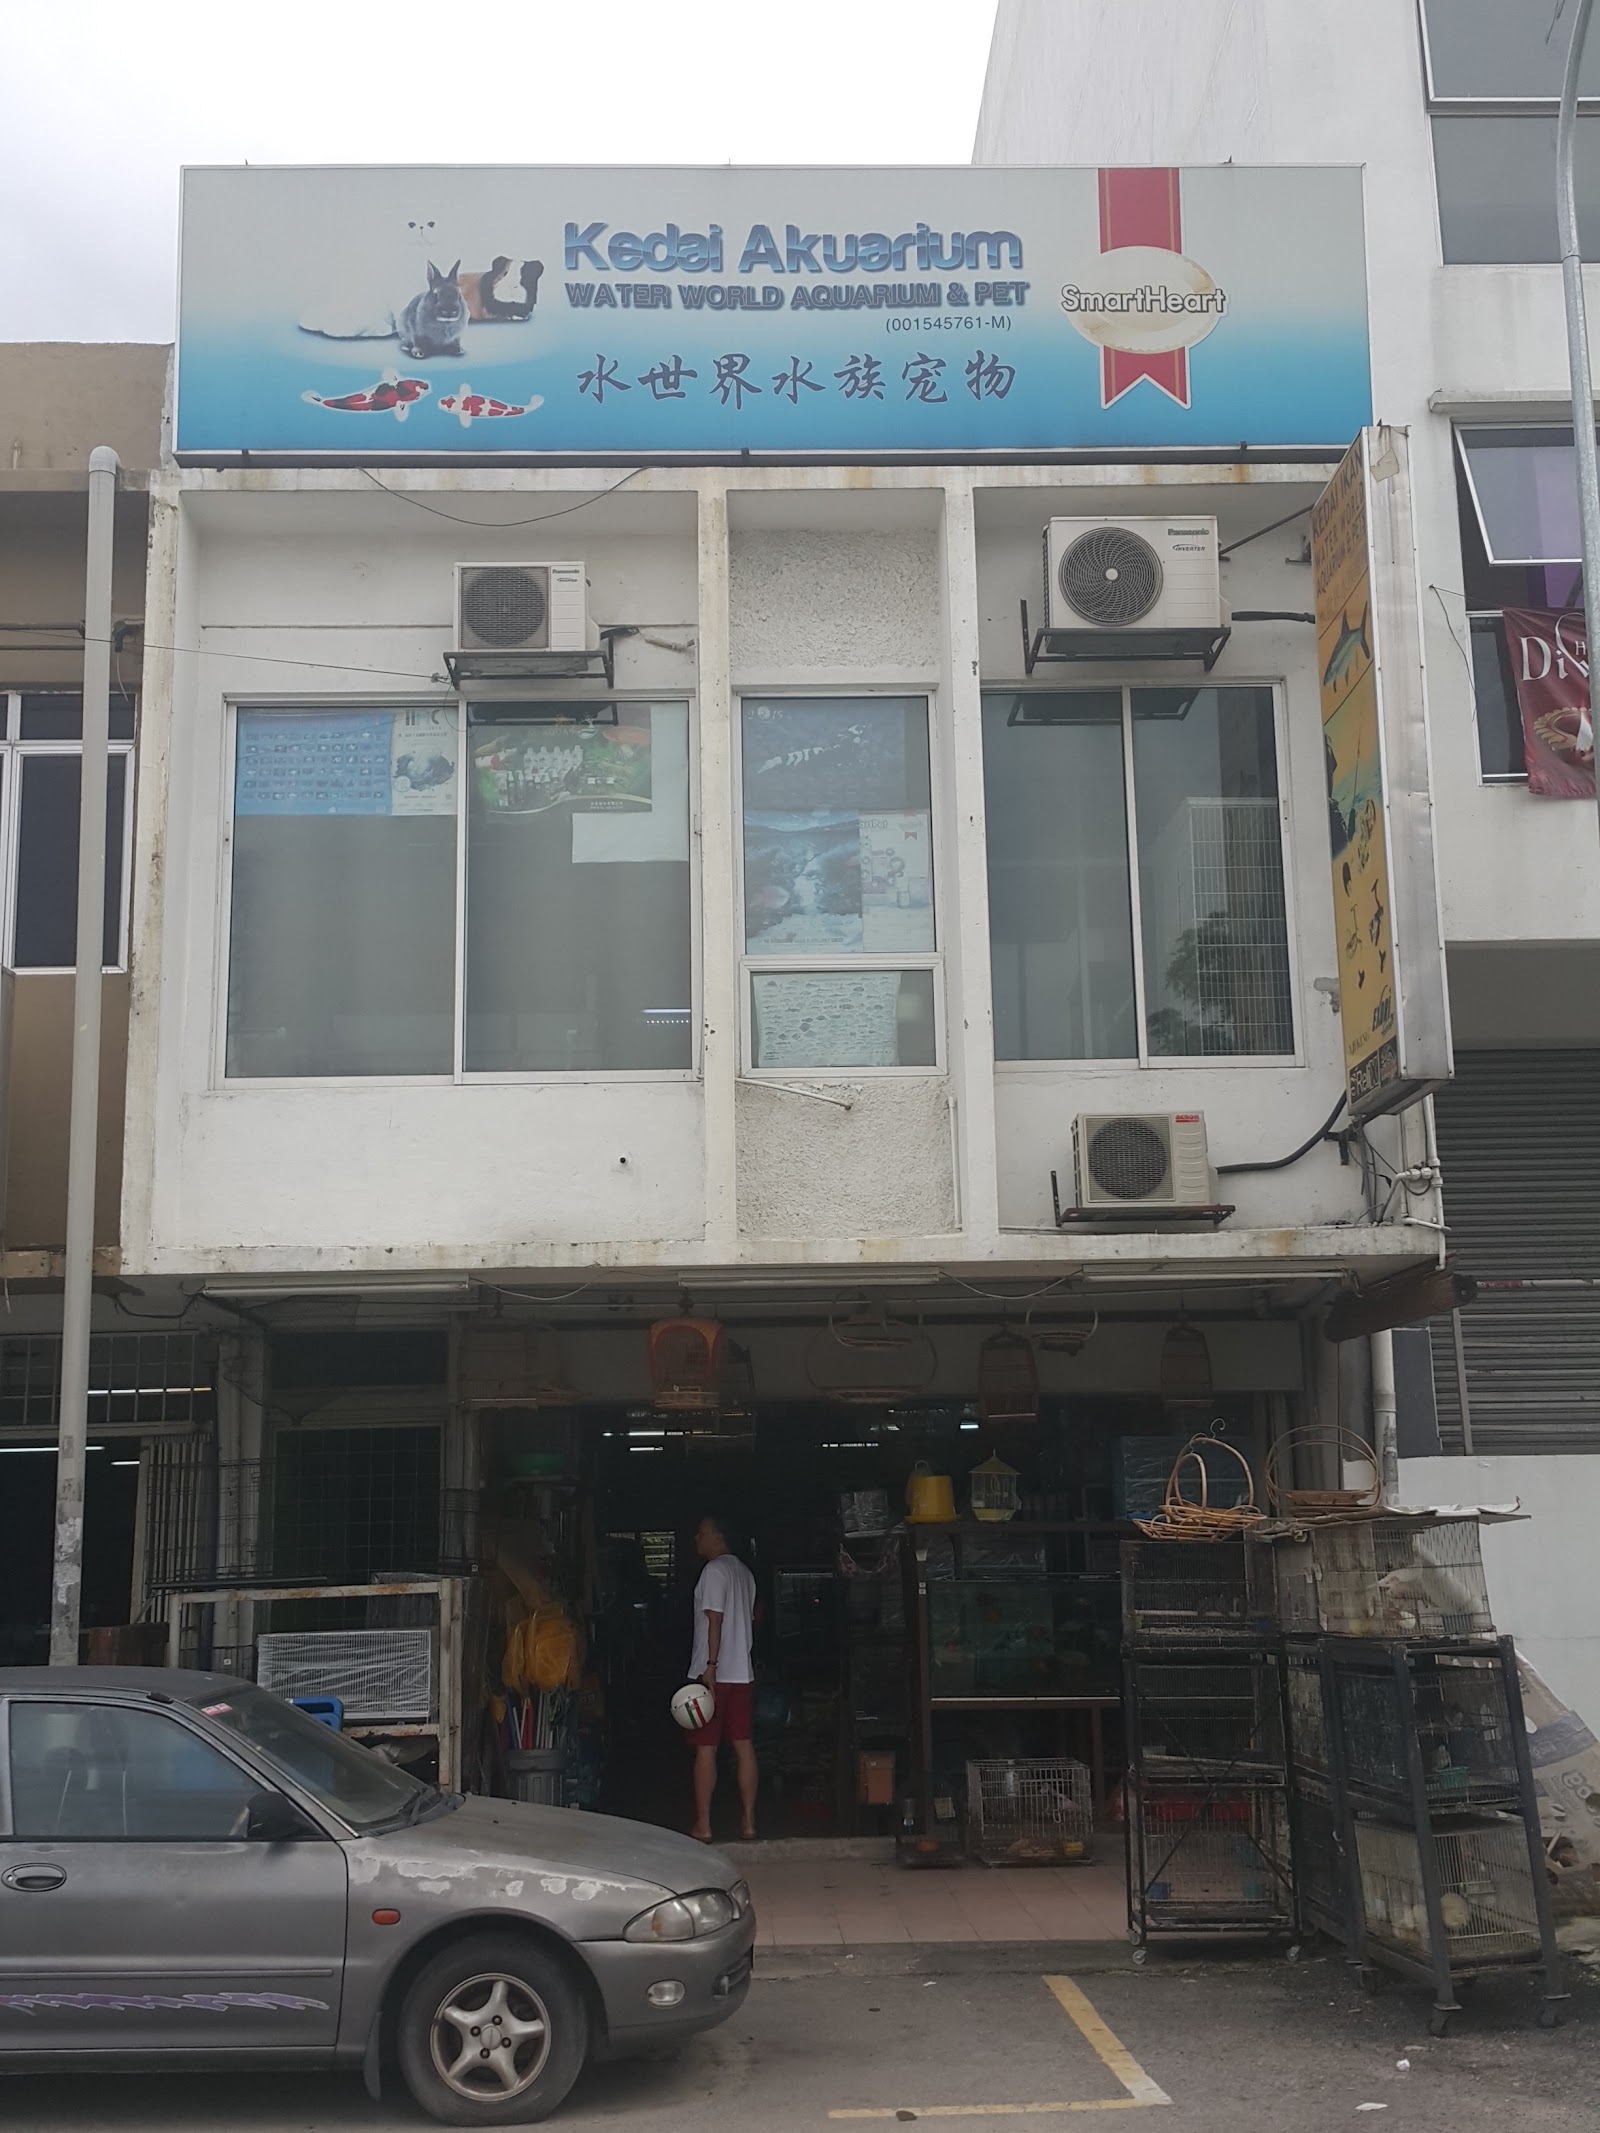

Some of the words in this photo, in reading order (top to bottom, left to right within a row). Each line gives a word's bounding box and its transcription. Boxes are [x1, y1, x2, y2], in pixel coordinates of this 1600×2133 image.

[564, 222, 724, 272] Kedai
[738, 223, 1023, 273] Akuarium
[565, 282, 672, 309] WATER
[677, 284, 785, 310] WORLD
[790, 282, 942, 310] AQUARIUM
[946, 282, 969, 306] &
[974, 281, 1030, 306] PET
[1061, 284, 1226, 313] SmartHeart
[885, 315, 1012, 333] (001545761-M)
[576, 349, 1017, 411] 水世界水族宠物
[1311, 489, 1339, 543] KEDAI
[1340, 447, 1363, 498] IKAN
[1314, 524, 1338, 568] WATER
[1339, 481, 1364, 533] WORLD
